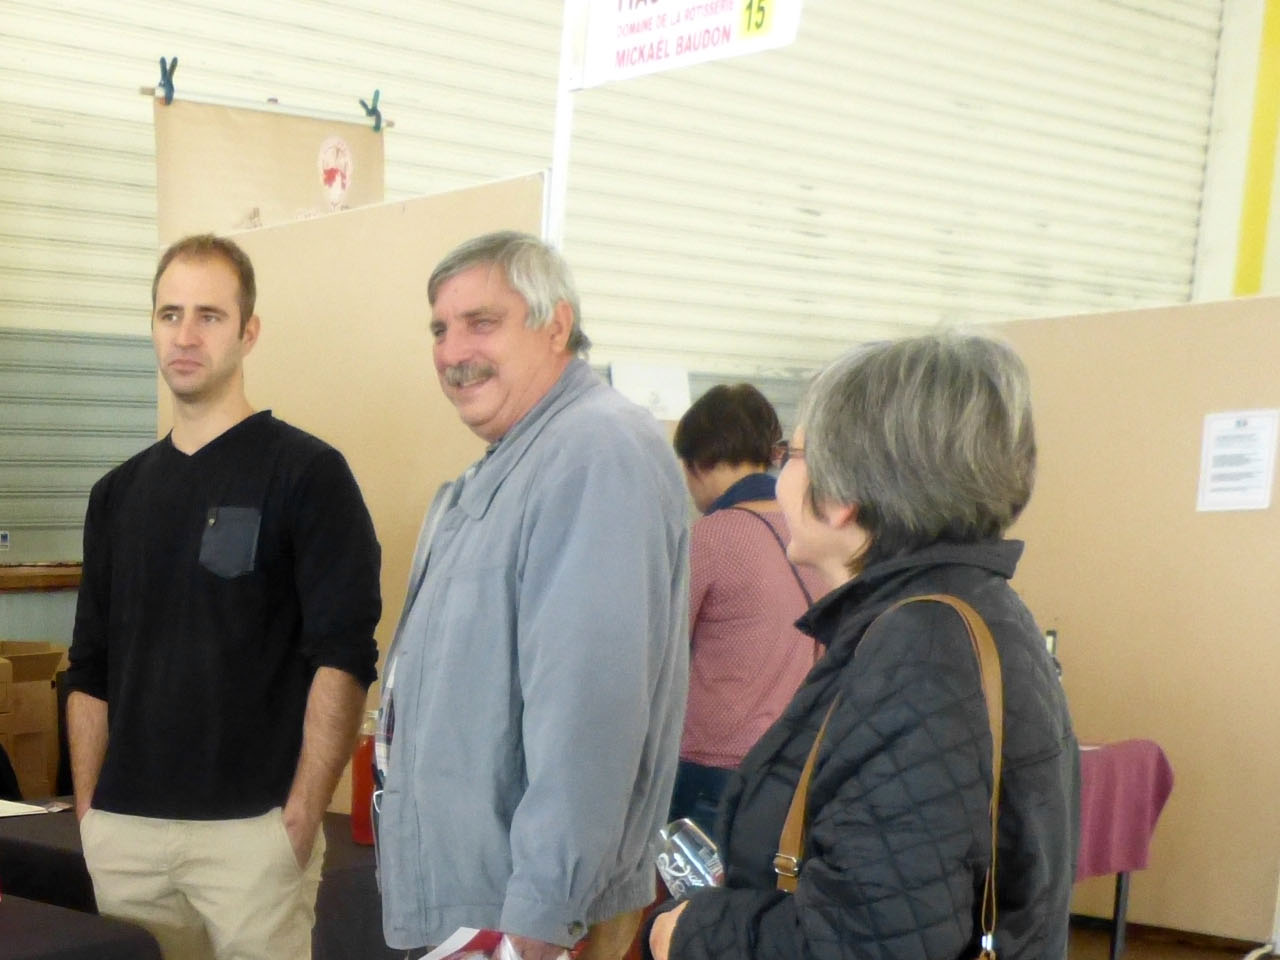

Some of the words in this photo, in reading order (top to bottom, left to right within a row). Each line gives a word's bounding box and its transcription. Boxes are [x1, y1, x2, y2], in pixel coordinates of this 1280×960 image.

[617, 17, 653, 37] DOMAINE
[656, 13, 666, 28] DE
[670, 9, 680, 26] LA
[746, 0, 765, 31] 15
[676, 24, 731, 56] BAUDON
